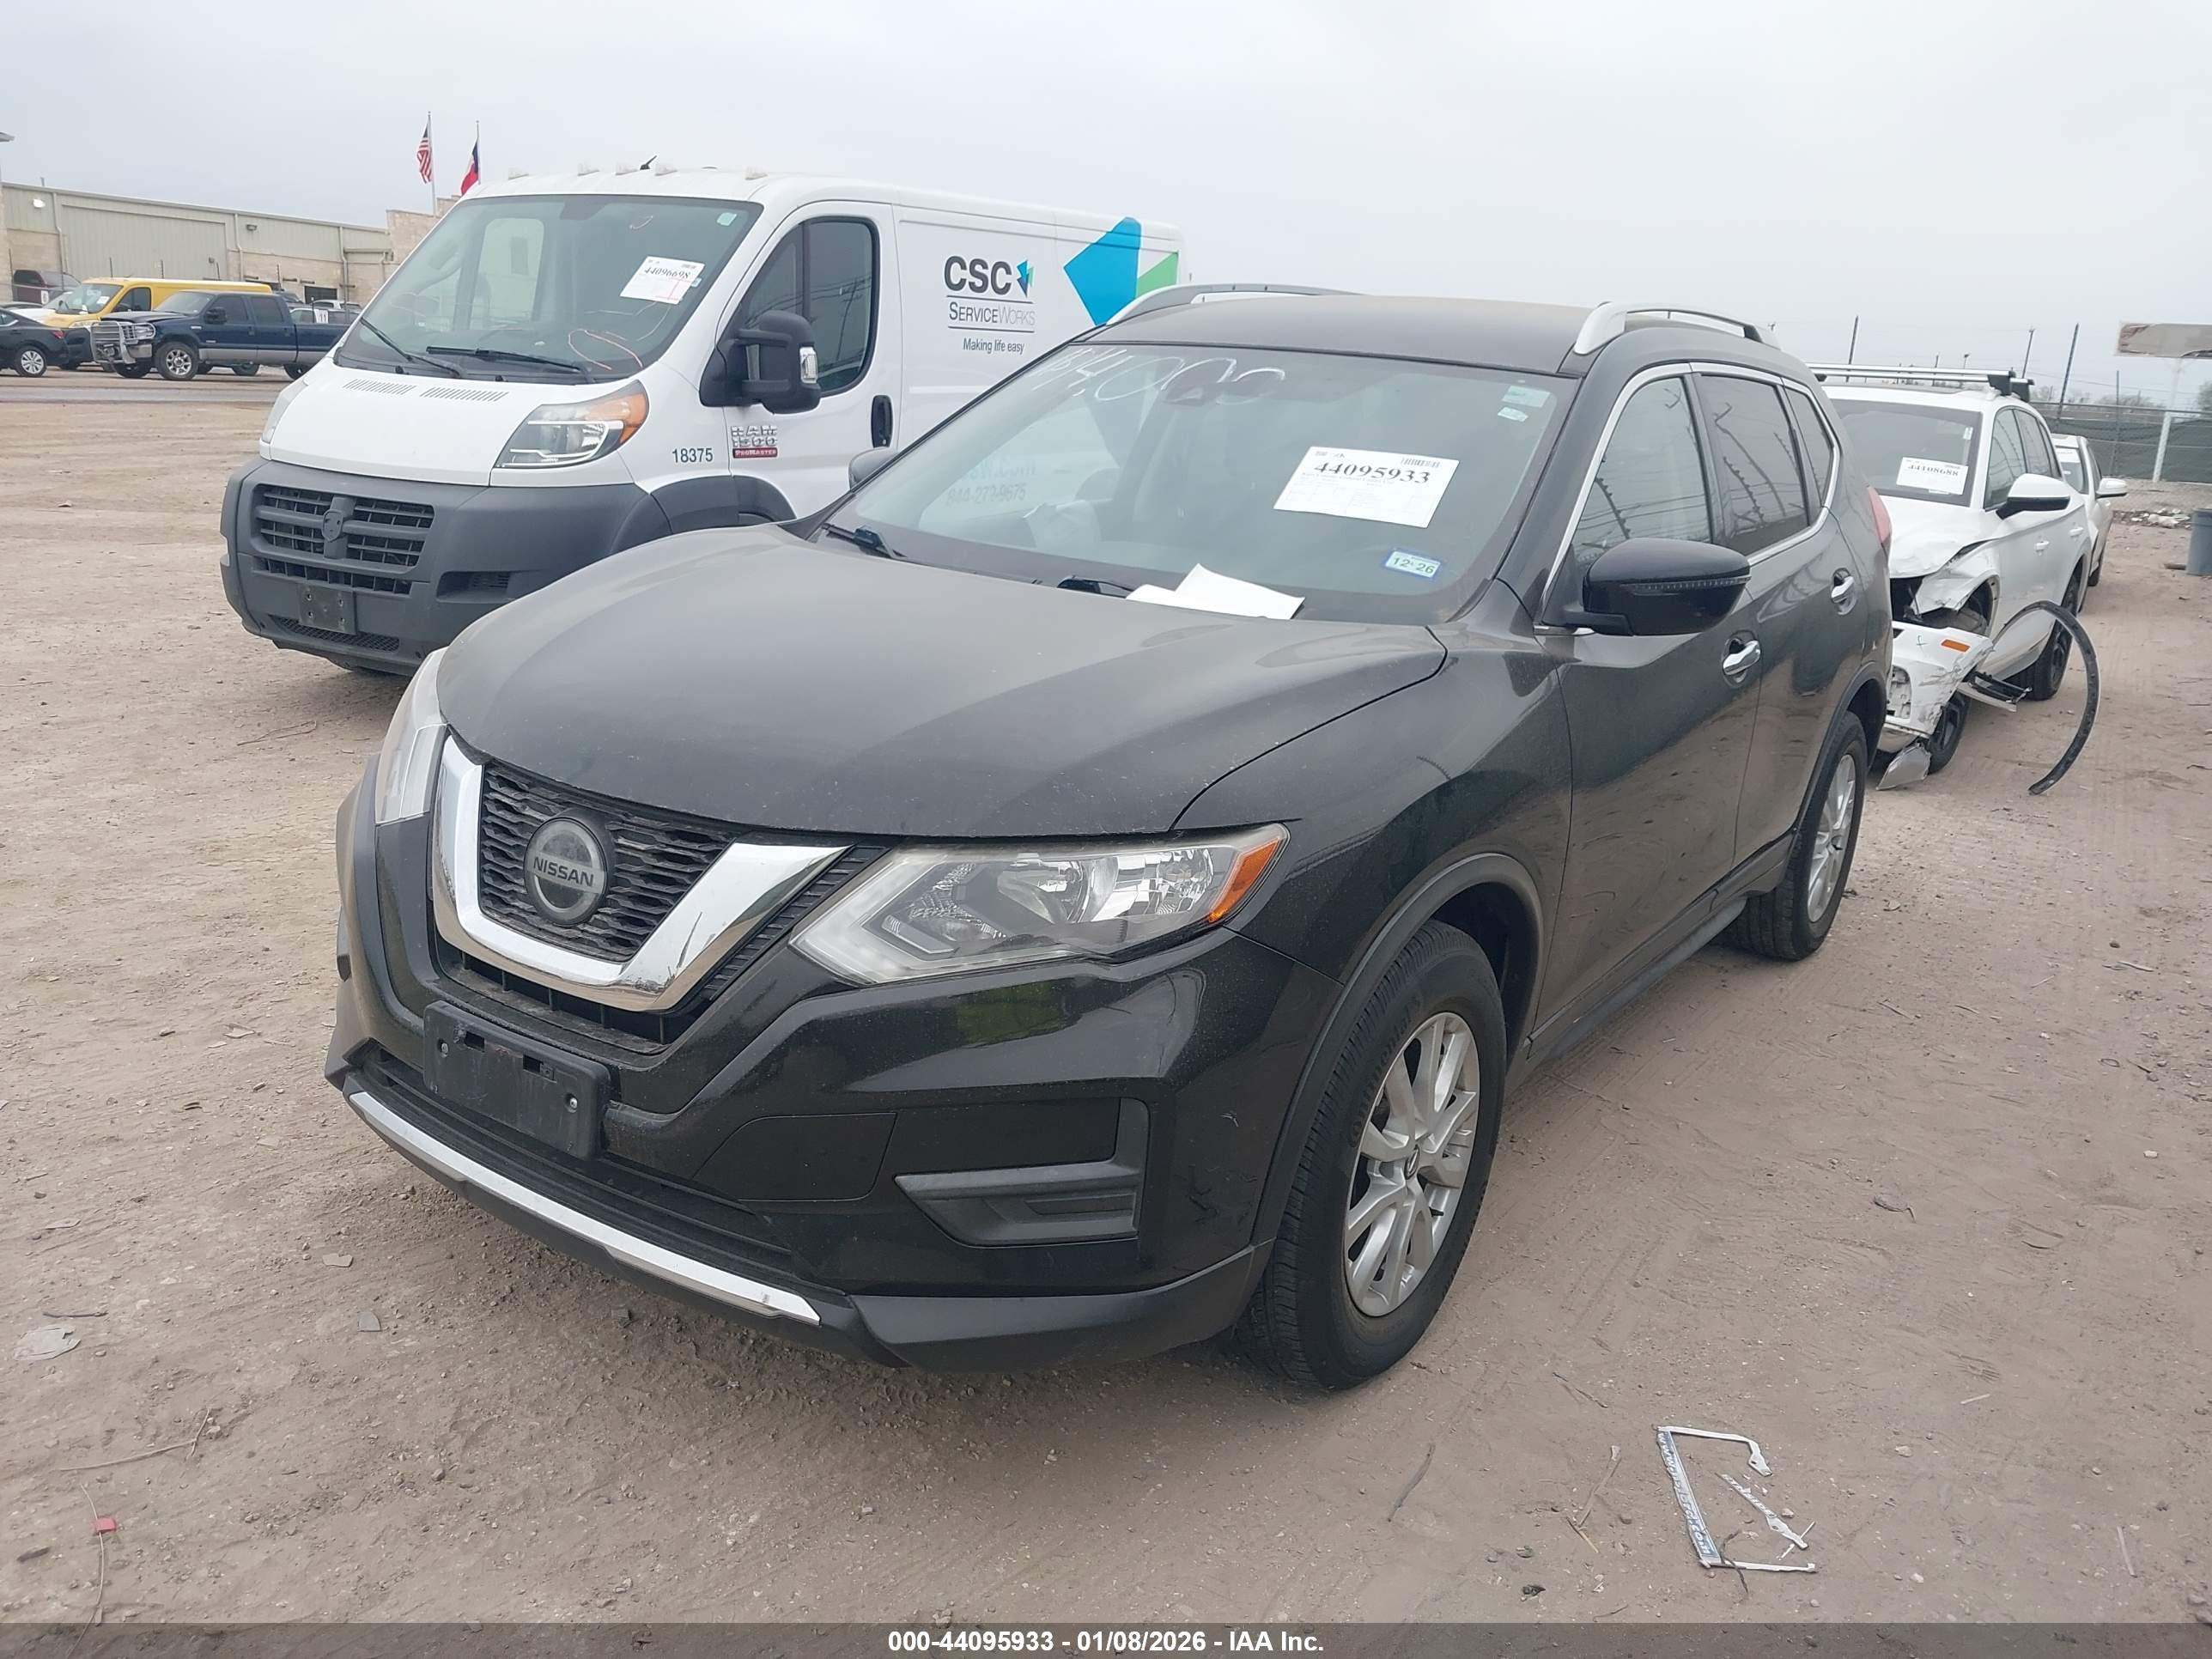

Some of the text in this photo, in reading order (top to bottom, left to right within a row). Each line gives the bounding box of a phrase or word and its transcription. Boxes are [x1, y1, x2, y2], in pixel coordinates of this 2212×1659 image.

[944, 255, 1012, 295] CSC
[963, 337, 1025, 355] Making life easy
[731, 425, 777, 436] RAM
[732, 436, 778, 447] 1500
[672, 447, 714, 463] 18375
[1314, 461, 1431, 484] 44095933
[533, 856, 594, 887] NISSAN
